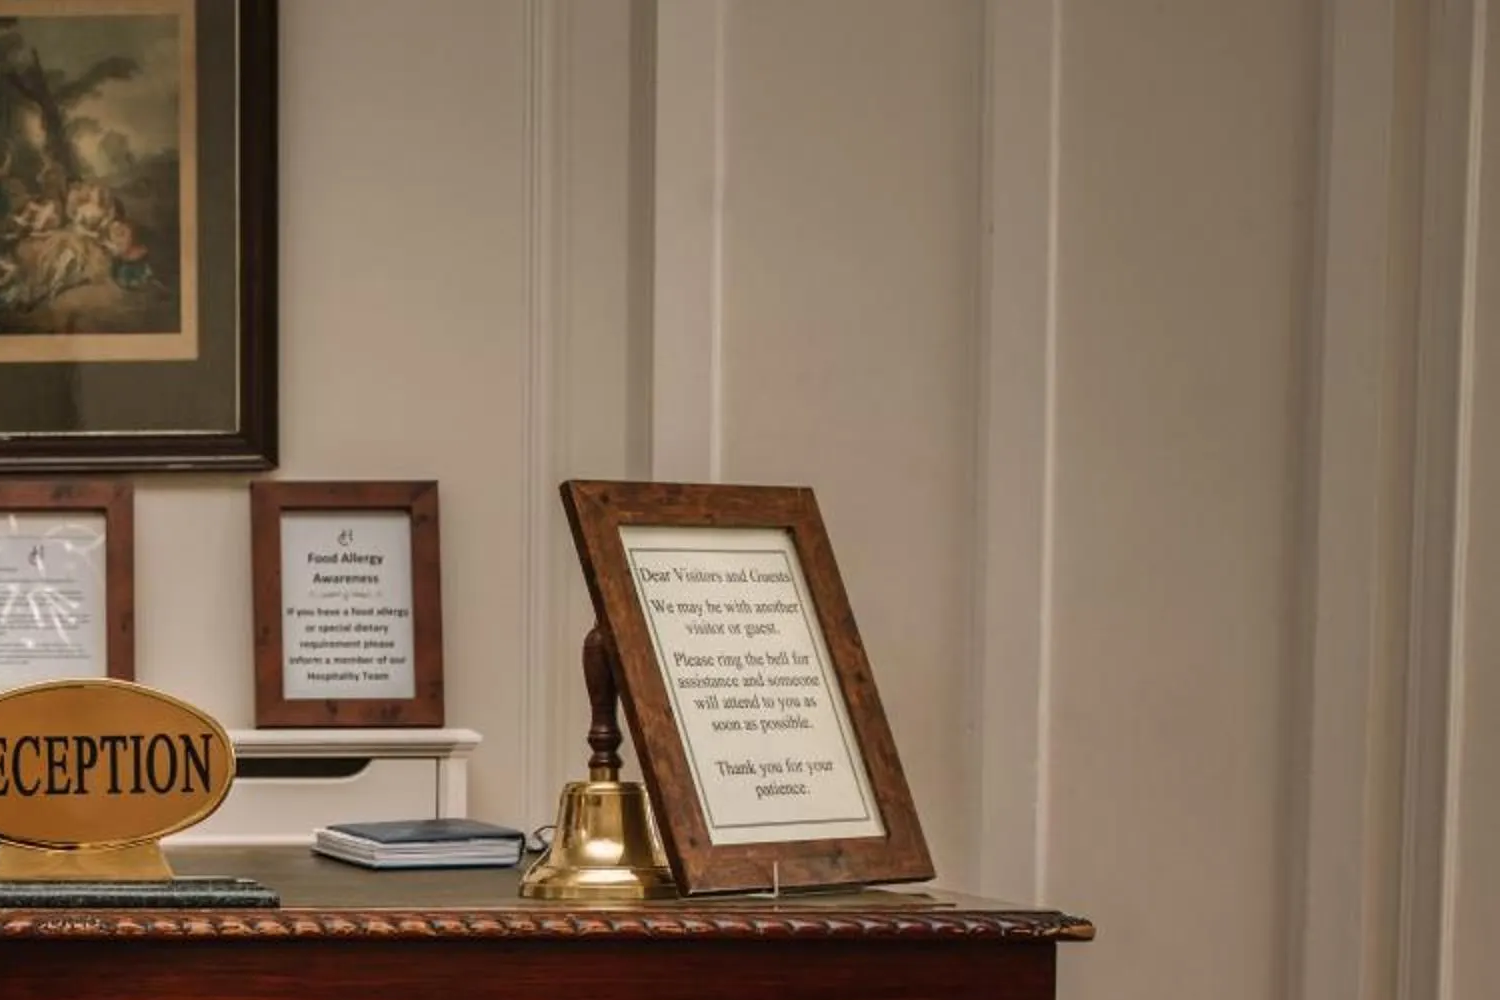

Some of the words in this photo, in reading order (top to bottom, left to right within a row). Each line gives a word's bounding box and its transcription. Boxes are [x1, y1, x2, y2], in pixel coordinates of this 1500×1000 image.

[307, 552, 338, 564] Food
[341, 552, 384, 565] Allergy
[313, 573, 379, 584] Awareness
[639, 567, 671, 583] Dear
[673, 567, 722, 583] Visitors
[725, 568, 747, 583] and
[297, 609, 314, 618] you
[317, 607, 340, 616] have
[351, 607, 374, 616] food
[376, 607, 409, 617] allergy
[650, 600, 674, 613] We
[677, 602, 703, 616] may
[705, 599, 722, 613] be
[725, 599, 751, 613] with
[755, 599, 798, 613] another
[305, 625, 315, 633] or
[318, 624, 352, 634] special
[354, 624, 389, 634] dietary
[685, 621, 725, 635] visitor
[727, 624, 740, 634] or
[743, 622, 780, 638] guest.
[299, 640, 361, 650] requirement
[363, 640, 395, 649] please
[289, 656, 322, 664] inform
[333, 656, 374, 664] member
[377, 656, 387, 664] of
[672, 651, 714, 667] Please
[717, 652, 743, 669] ring
[745, 651, 765, 666] the
[767, 651, 789, 666] bell
[791, 651, 810, 666] for
[307, 672, 360, 682] Hospitality
[362, 672, 389, 680] Team
[677, 674, 739, 688] assistance
[743, 673, 765, 687] and
[768, 674, 820, 687] someone
[694, 695, 719, 710] will
[723, 694, 758, 710] attend
[761, 696, 775, 709] to
[778, 697, 801, 711] you
[803, 697, 817, 708] as
[711, 719, 741, 731] soon
[744, 719, 757, 730] as
[760, 717, 813, 734] possible.
[715, 759, 757, 776] Thank
[759, 762, 783, 777] you
[786, 758, 802, 773] for
[805, 760, 833, 776] your
[756, 783, 810, 799] patience.
